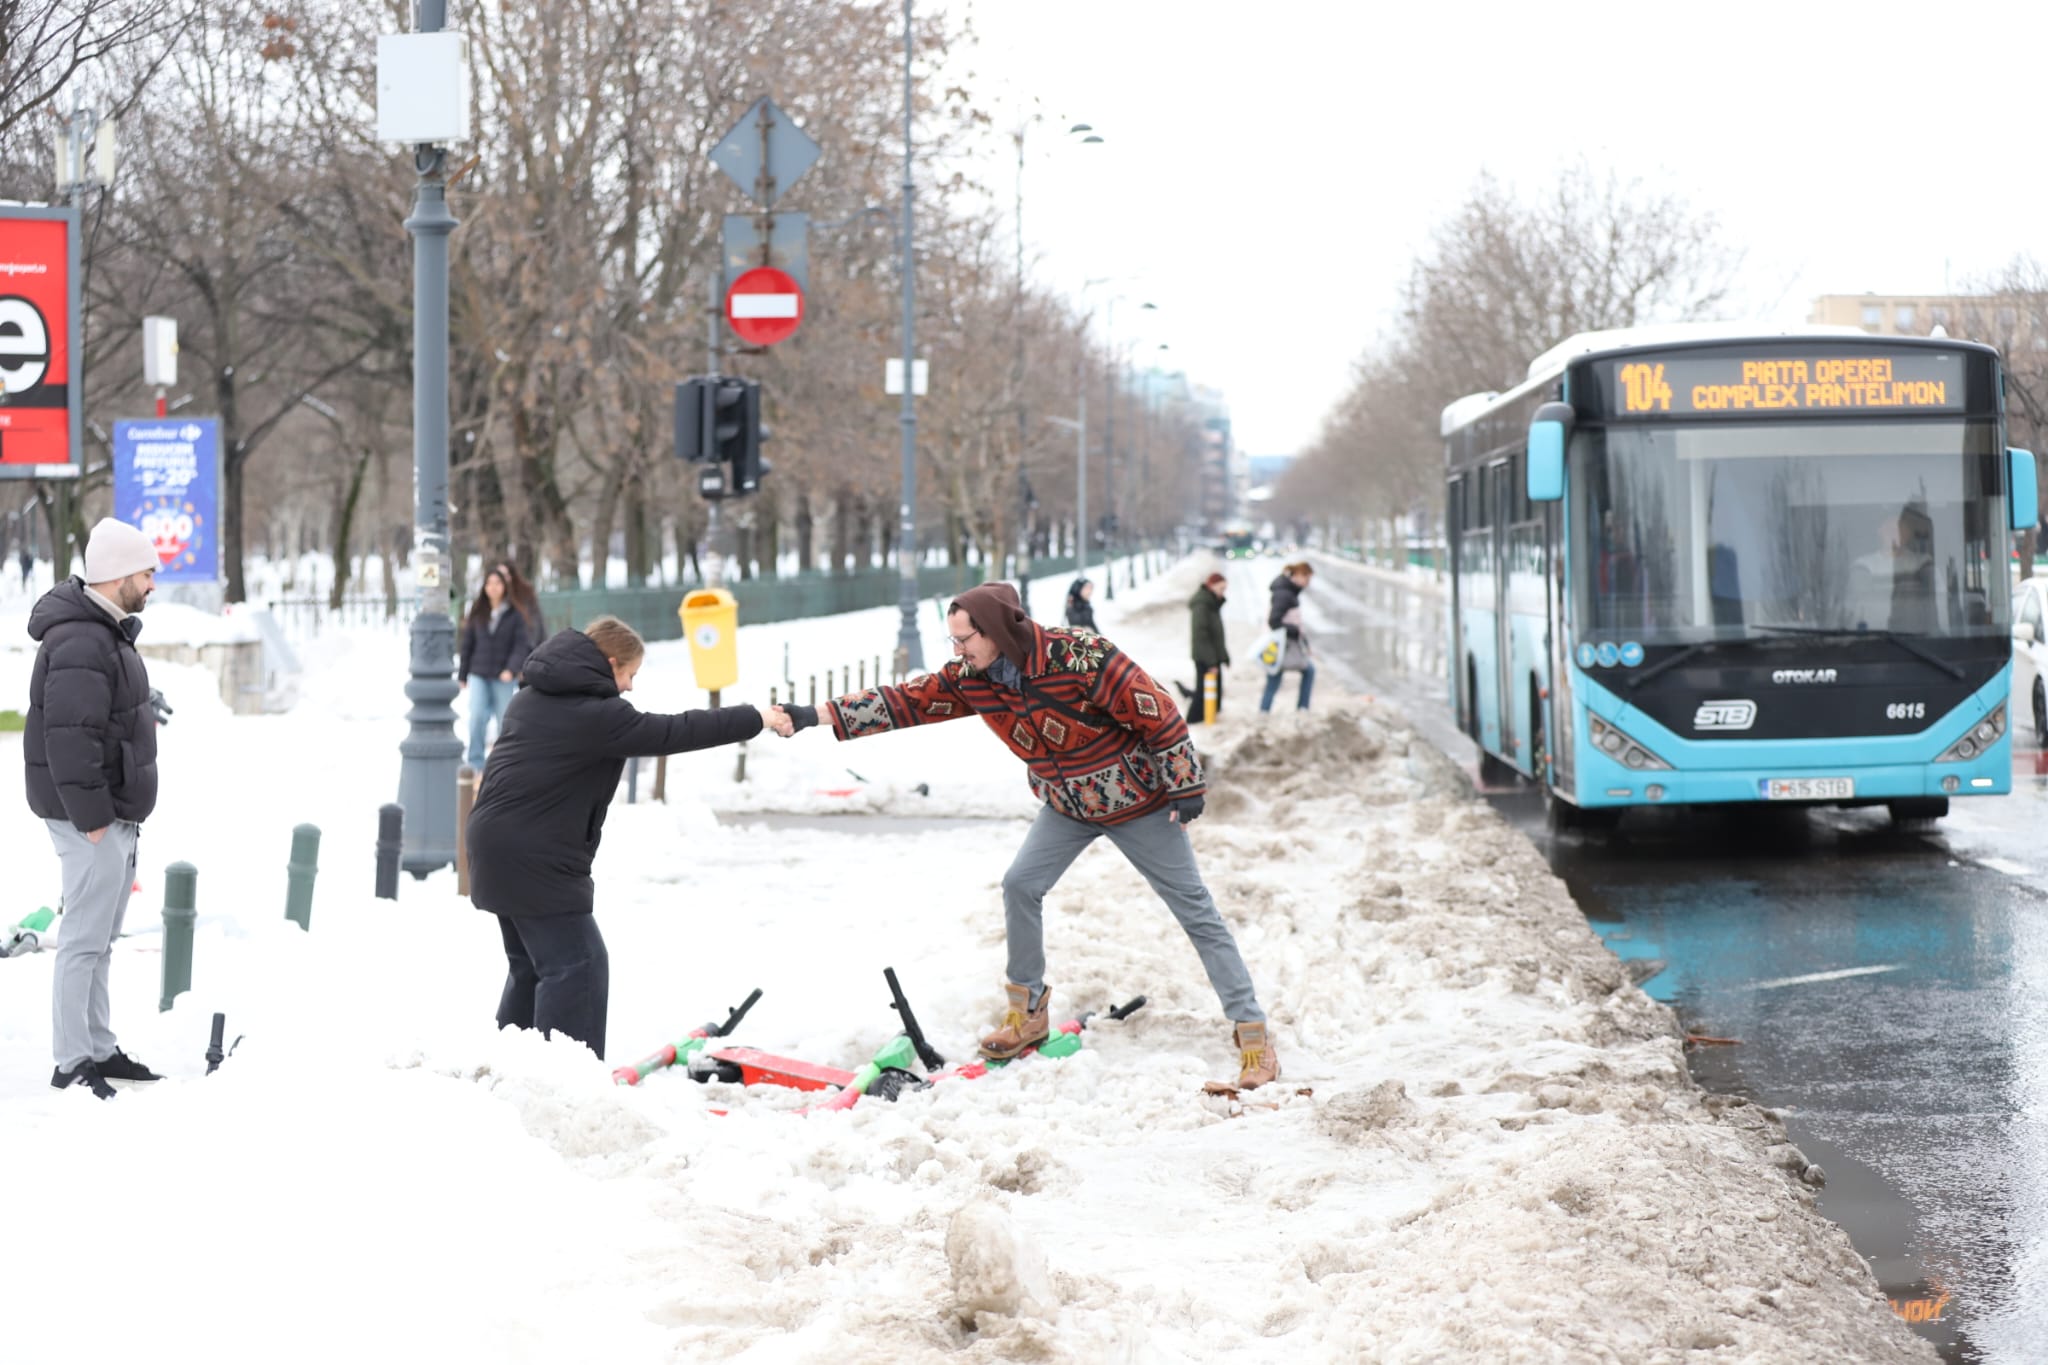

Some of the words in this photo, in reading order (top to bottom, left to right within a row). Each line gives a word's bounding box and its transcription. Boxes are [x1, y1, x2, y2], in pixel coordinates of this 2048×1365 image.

[1743, 361, 1808, 385] PIATA
[1815, 359, 1892, 382] OPEREI
[1620, 362, 1672, 411] 104
[1692, 384, 1798, 409] COMPLEX
[1805, 381, 1946, 406] PANTELIMON
[1772, 669, 1837, 684] OTOKAR
[1694, 704, 1752, 726] STB
[1886, 702, 1925, 719] 6615
[1815, 780, 1848, 797] STB
